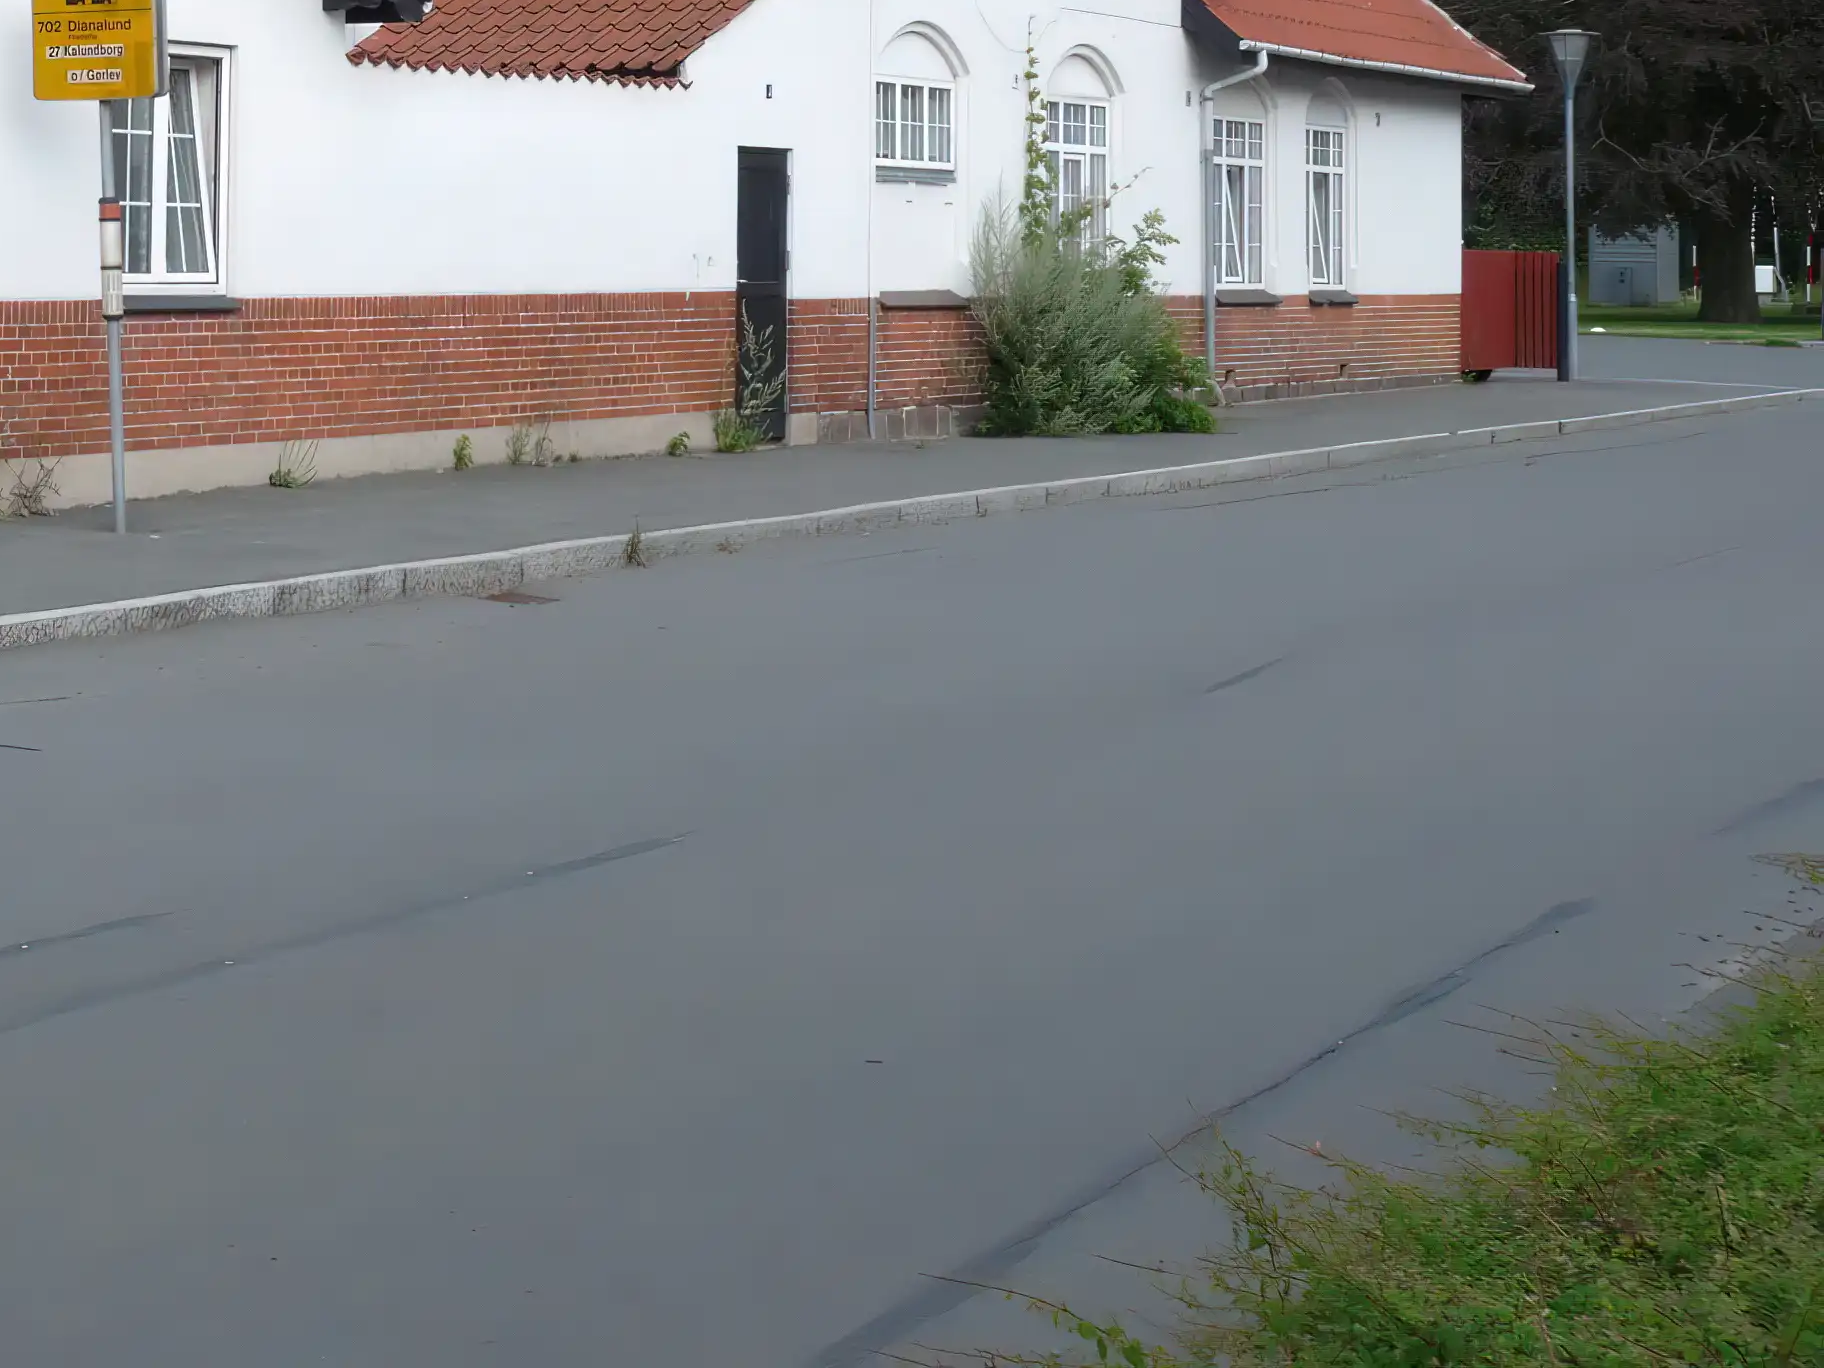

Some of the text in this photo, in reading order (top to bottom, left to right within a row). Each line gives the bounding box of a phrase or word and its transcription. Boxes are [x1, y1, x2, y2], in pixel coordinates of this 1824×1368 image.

[37, 19, 131, 33] 702 Dianalund
[48, 44, 123, 58] 27 Kalundborg
